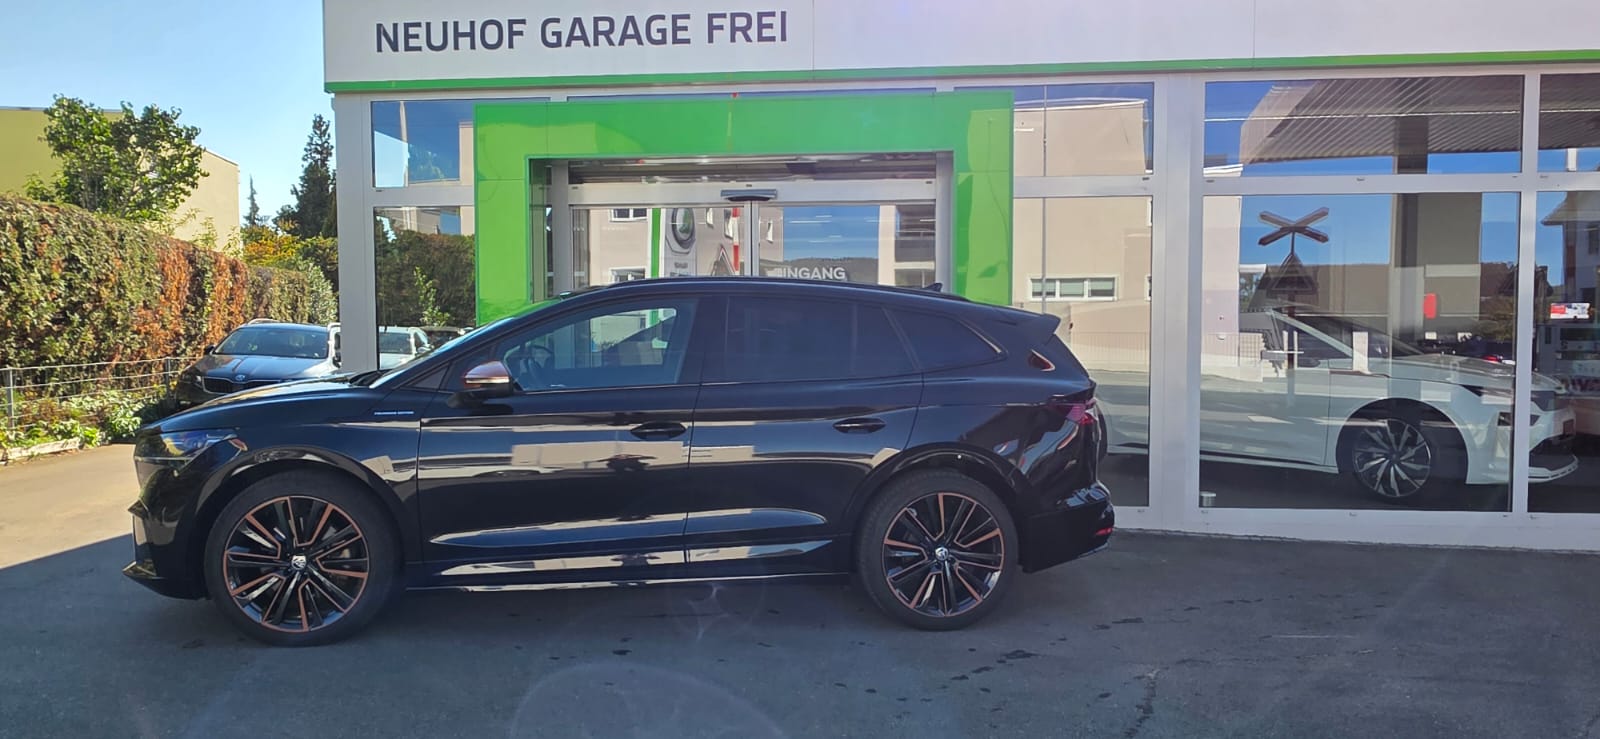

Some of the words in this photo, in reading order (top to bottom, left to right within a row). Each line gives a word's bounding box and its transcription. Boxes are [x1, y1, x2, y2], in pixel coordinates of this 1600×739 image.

[375, 18, 526, 53] NEUHOF
[540, 13, 691, 48] GARAGE
[706, 10, 787, 44] FREI
